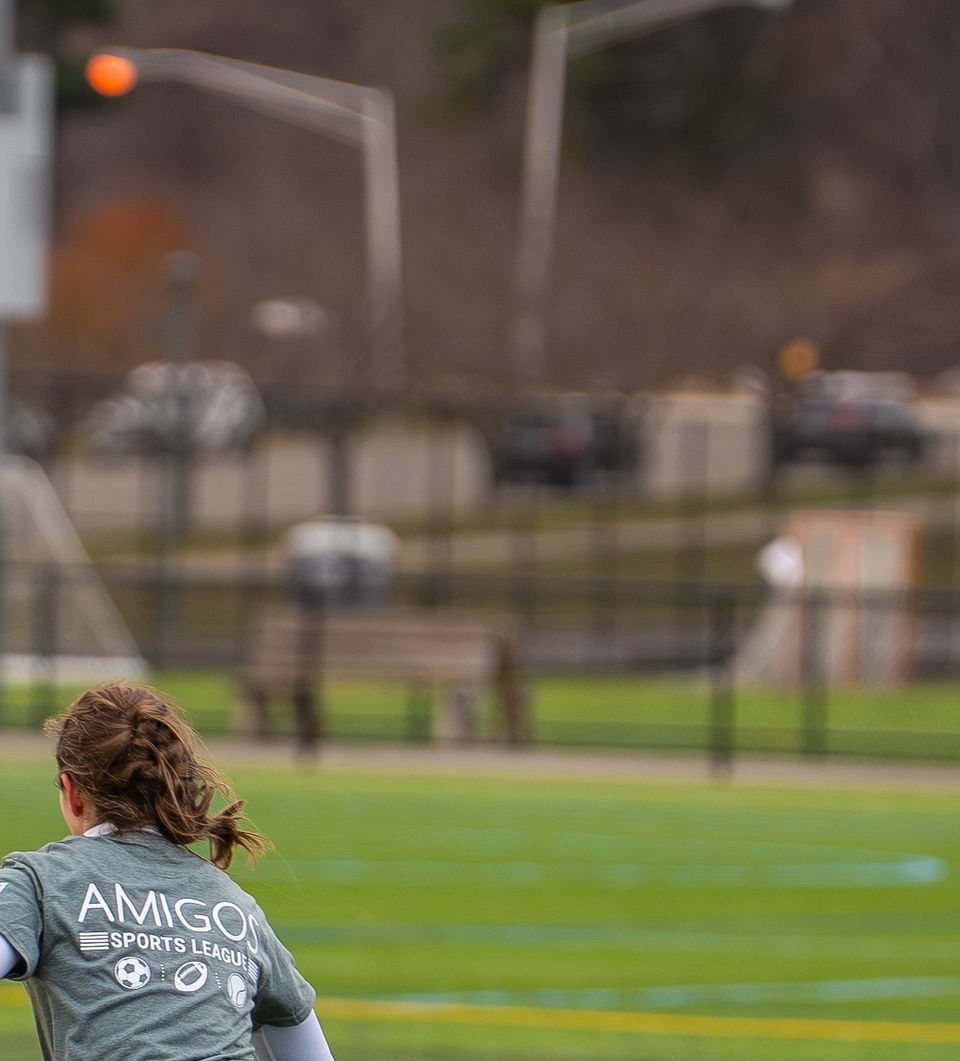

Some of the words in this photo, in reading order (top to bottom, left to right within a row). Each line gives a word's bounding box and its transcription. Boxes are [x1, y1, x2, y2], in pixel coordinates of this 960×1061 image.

[78, 883, 259, 954] AMIGOS
[110, 931, 186, 953] SPORTS
[192, 938, 248, 971] LEAGUE
